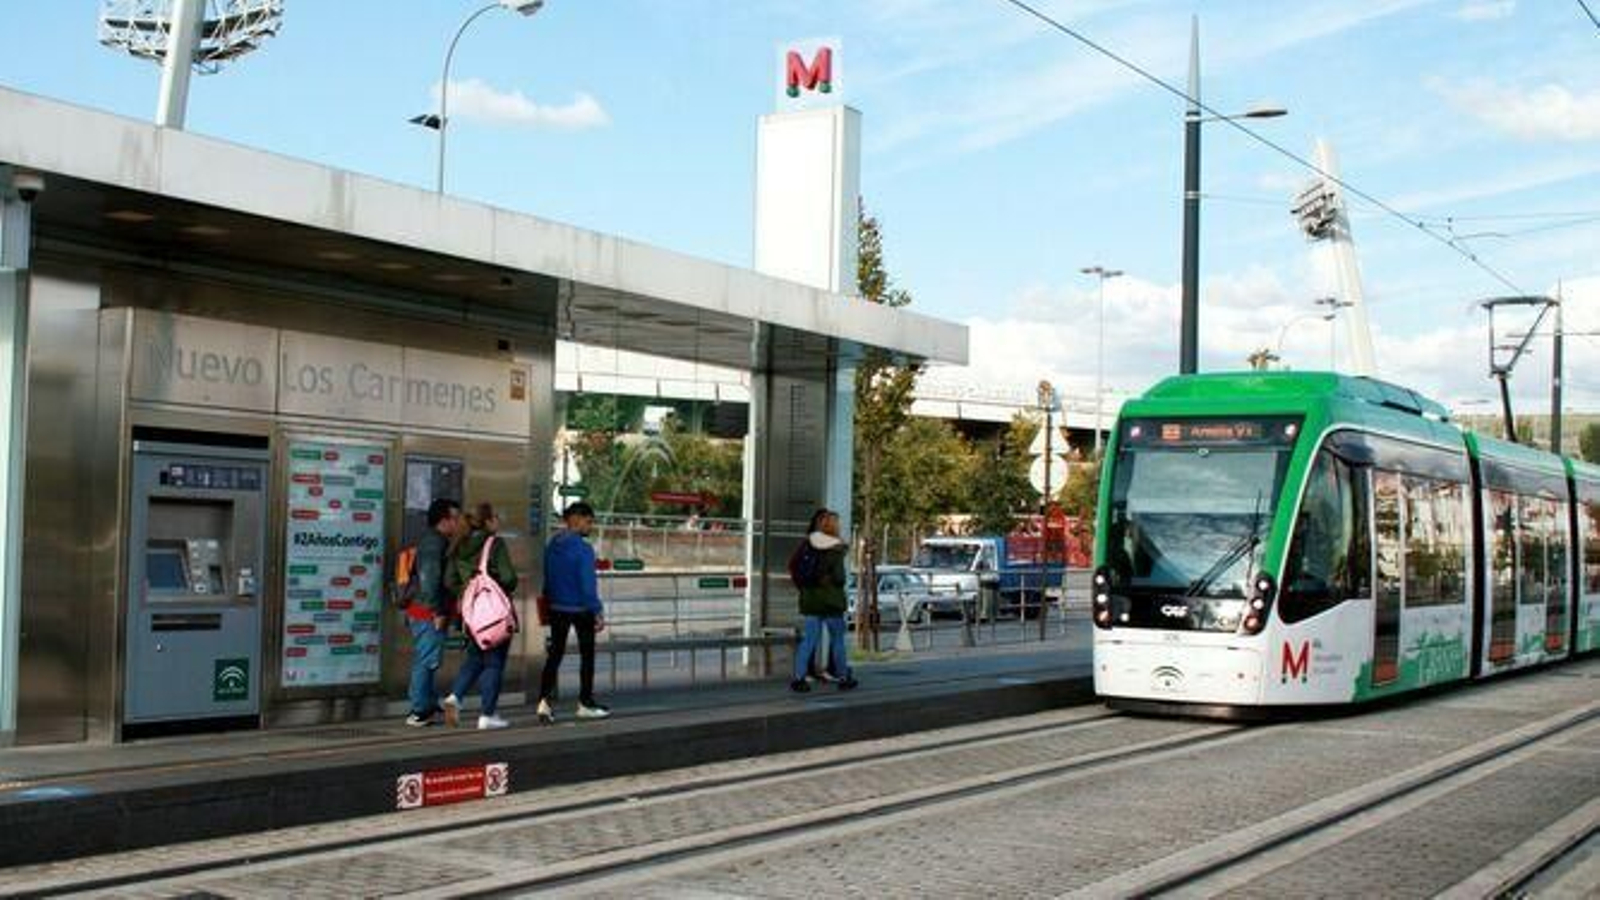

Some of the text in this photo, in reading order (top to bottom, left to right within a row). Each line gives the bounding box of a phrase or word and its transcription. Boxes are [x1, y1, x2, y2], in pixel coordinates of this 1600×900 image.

[786, 47, 832, 98] M
[149, 340, 263, 386] Nuevo
[282, 353, 334, 394] Los
[1281, 639, 1310, 684] M
